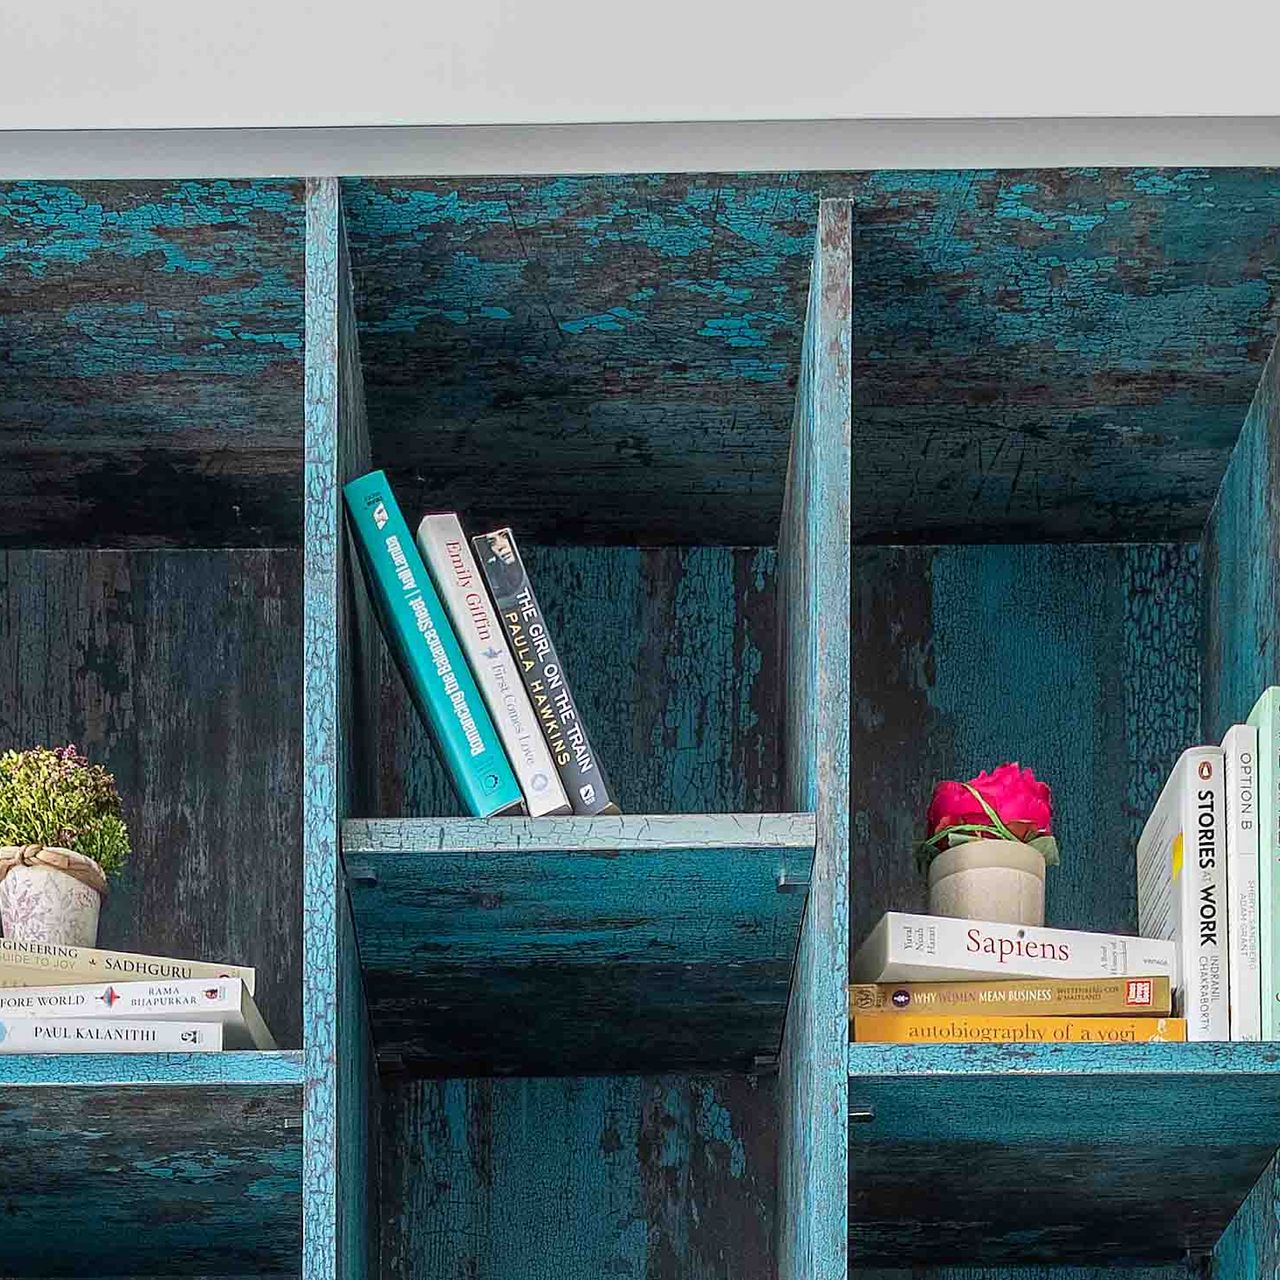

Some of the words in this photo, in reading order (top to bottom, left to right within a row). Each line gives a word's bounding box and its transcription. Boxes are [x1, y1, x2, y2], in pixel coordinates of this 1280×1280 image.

[446, 541, 472, 588] Emily
[466, 593, 490, 641] Giffin
[409, 598, 432, 632] Sheet
[424, 628, 451, 675] Balance
[506, 613, 534, 672] PAULA
[531, 681, 570, 765] HAWKINS
[516, 588, 538, 621] THE
[529, 623, 550, 663] GIRL
[544, 663, 562, 689] ON
[554, 689, 575, 724] THE
[568, 724, 592, 773] TRAIN
[446, 690, 485, 756] Romancing
[1240, 753, 1252, 814] OPTION
[1198, 790, 1215, 869] STORIES
[1241, 821, 1252, 829] B
[1200, 884, 1216, 946] WORK
[966, 929, 1070, 963] Sapiens
[105, 958, 193, 979] SADHGURU
[37, 994, 85, 1006] WORLD
[913, 993, 936, 1004] WHY
[979, 991, 1006, 1003] MEAN
[1009, 989, 1051, 1003] BUSINESS
[34, 1027, 71, 1039] PAUL
[76, 1028, 157, 1041] KALANITHI
[908, 1023, 1047, 1041] autobiography
[1054, 1024, 1073, 1041] of
[1080, 1027, 1093, 1040] a
